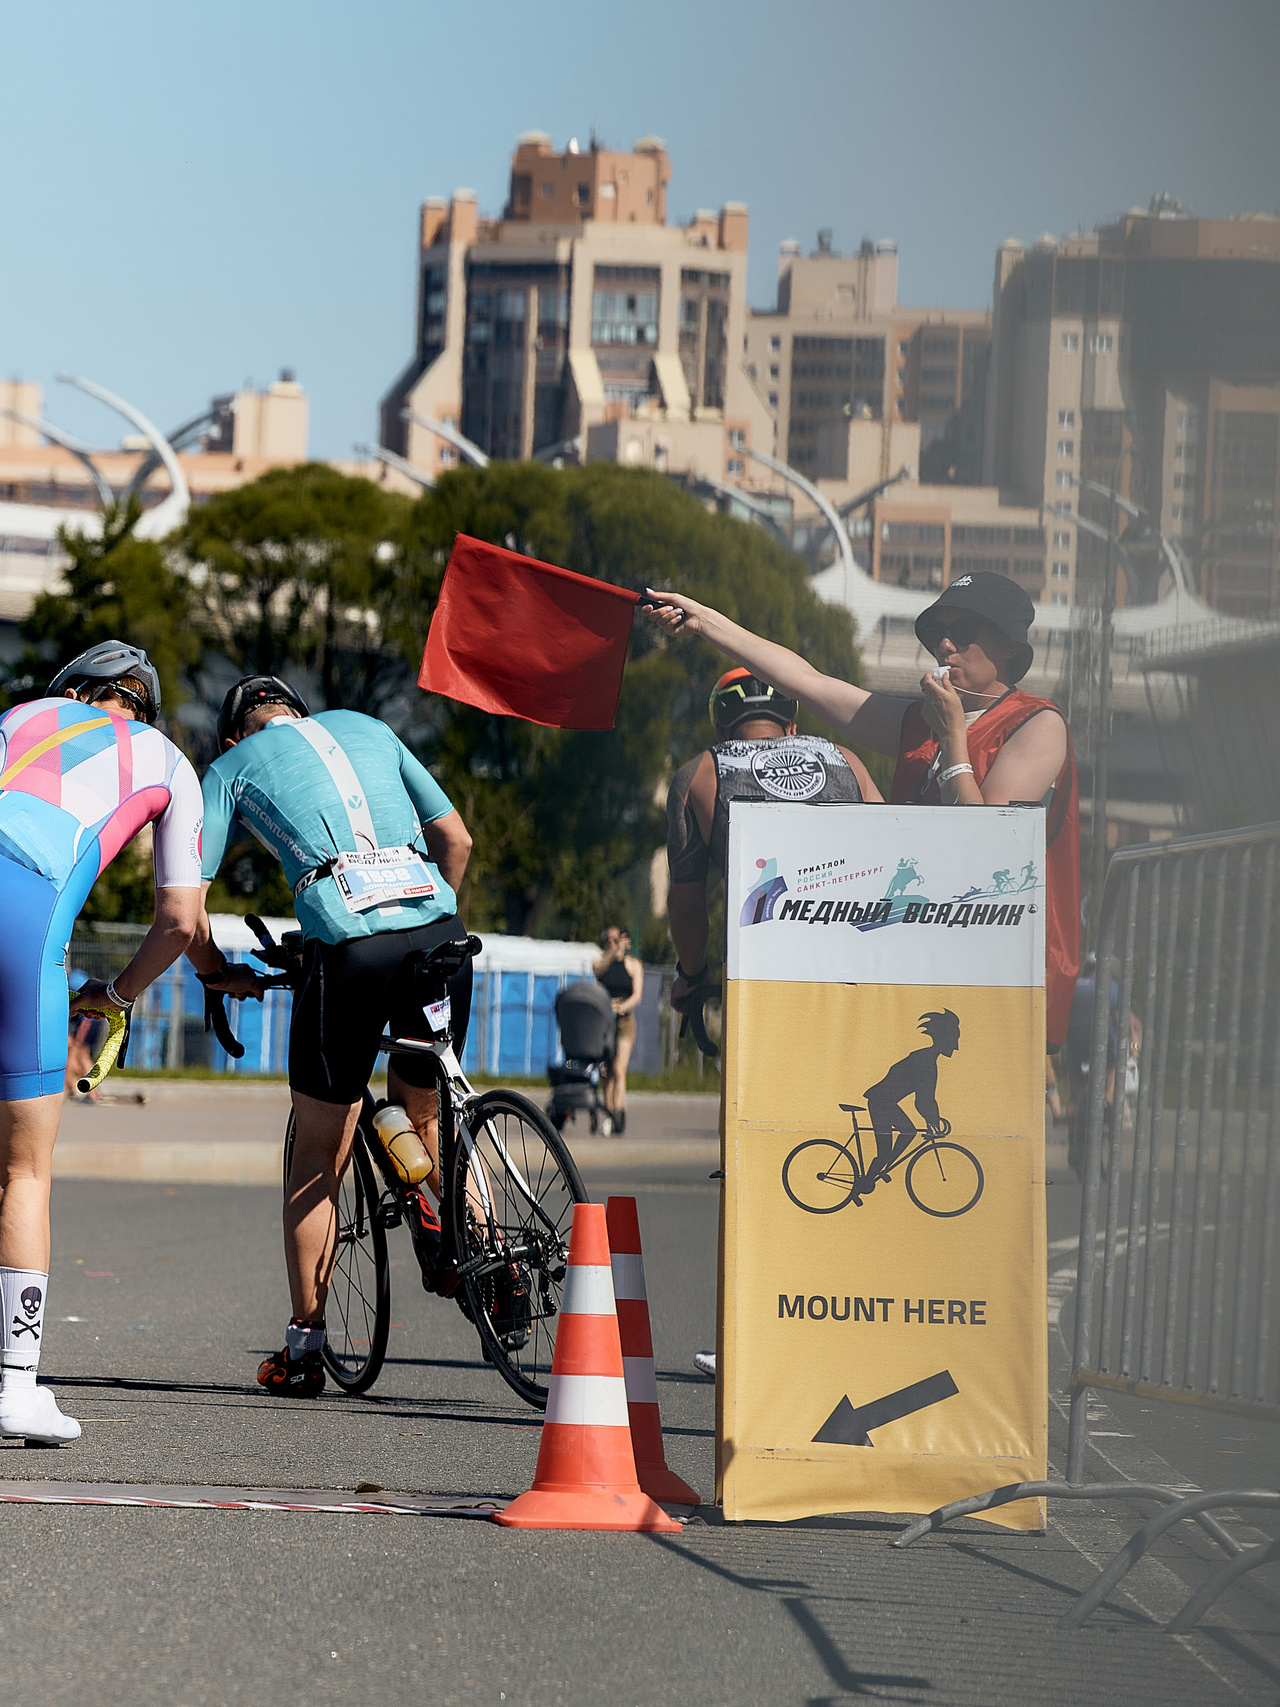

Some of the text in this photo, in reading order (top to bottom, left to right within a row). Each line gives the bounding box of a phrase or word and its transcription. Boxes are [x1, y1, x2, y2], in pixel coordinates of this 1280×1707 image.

[355, 867, 412, 884] 1598
[797, 858, 846, 876] ТРИАТЛОН
[362, 880, 415, 893] КОНСТАНТИН
[796, 865, 885, 893] САНКТ-ПЕТЕРБУРГ
[797, 870, 833, 885] РОССИЯ
[778, 898, 893, 925] МЕДНЫЙ
[902, 902, 1025, 928] ВСАДНИК
[777, 1294, 987, 1325] MOUNT HERE
